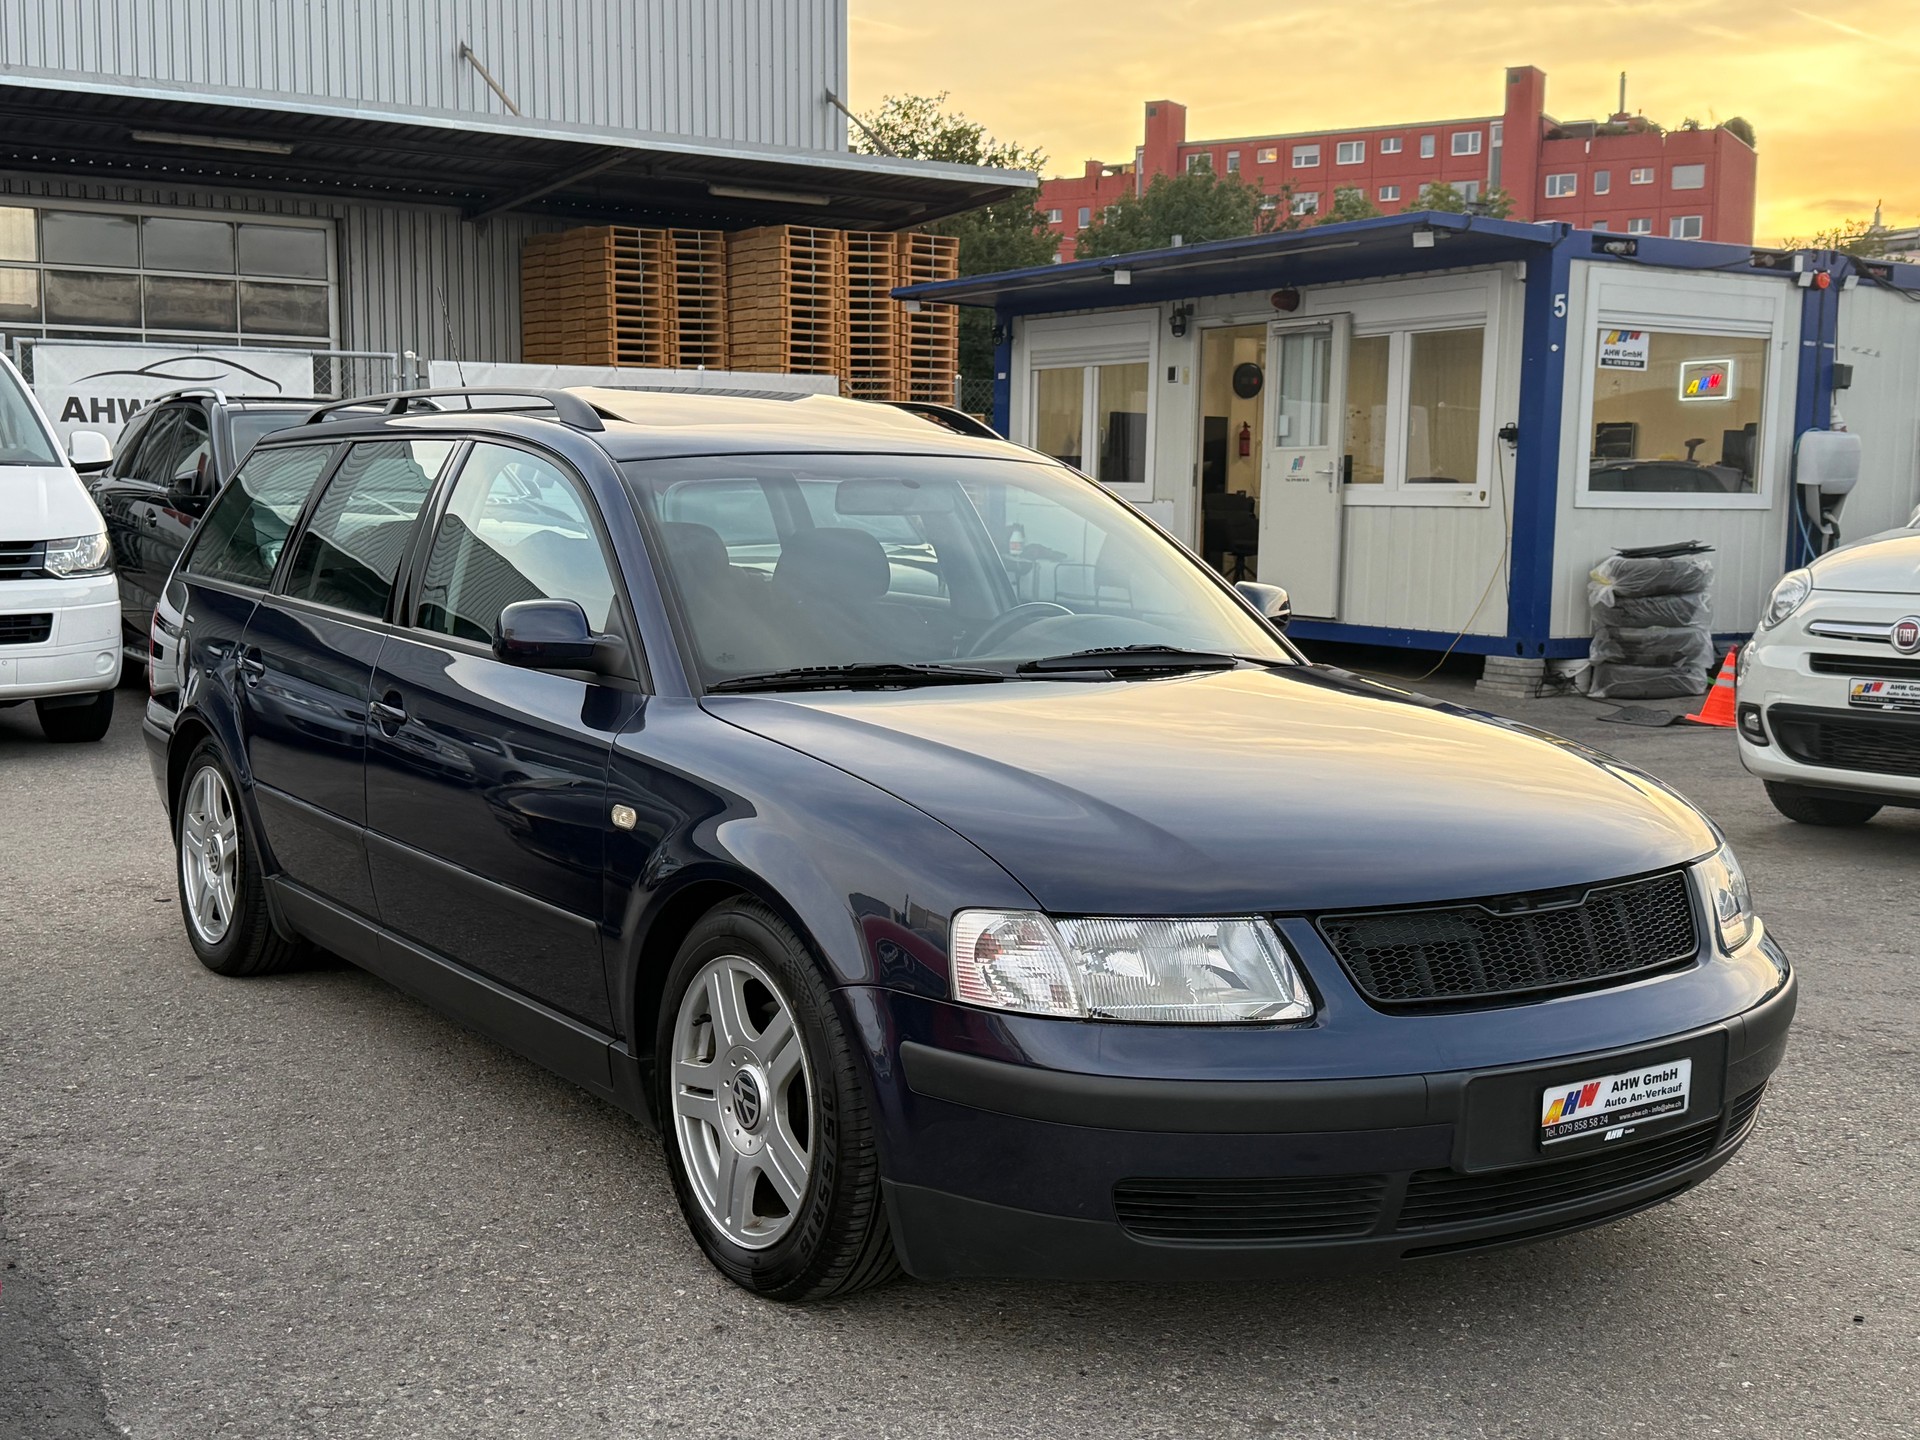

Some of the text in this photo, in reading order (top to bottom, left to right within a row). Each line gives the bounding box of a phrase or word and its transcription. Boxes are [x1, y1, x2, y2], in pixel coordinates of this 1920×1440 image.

[1554, 293, 1567, 318] 5
[1604, 349, 1620, 357] AHW
[1686, 373, 1722, 394] AHW
[1899, 628, 1917, 642] FIAT
[1852, 681, 1884, 695] AHW
[1611, 1068, 1678, 1093] AHW GmbH
[1542, 1081, 1601, 1126] AHW
[1604, 1082, 1682, 1108] Auto An-Verkauf
[1545, 1115, 1609, 1137] Tel. 079 858 58 24
[1604, 1127, 1624, 1141] AHW
